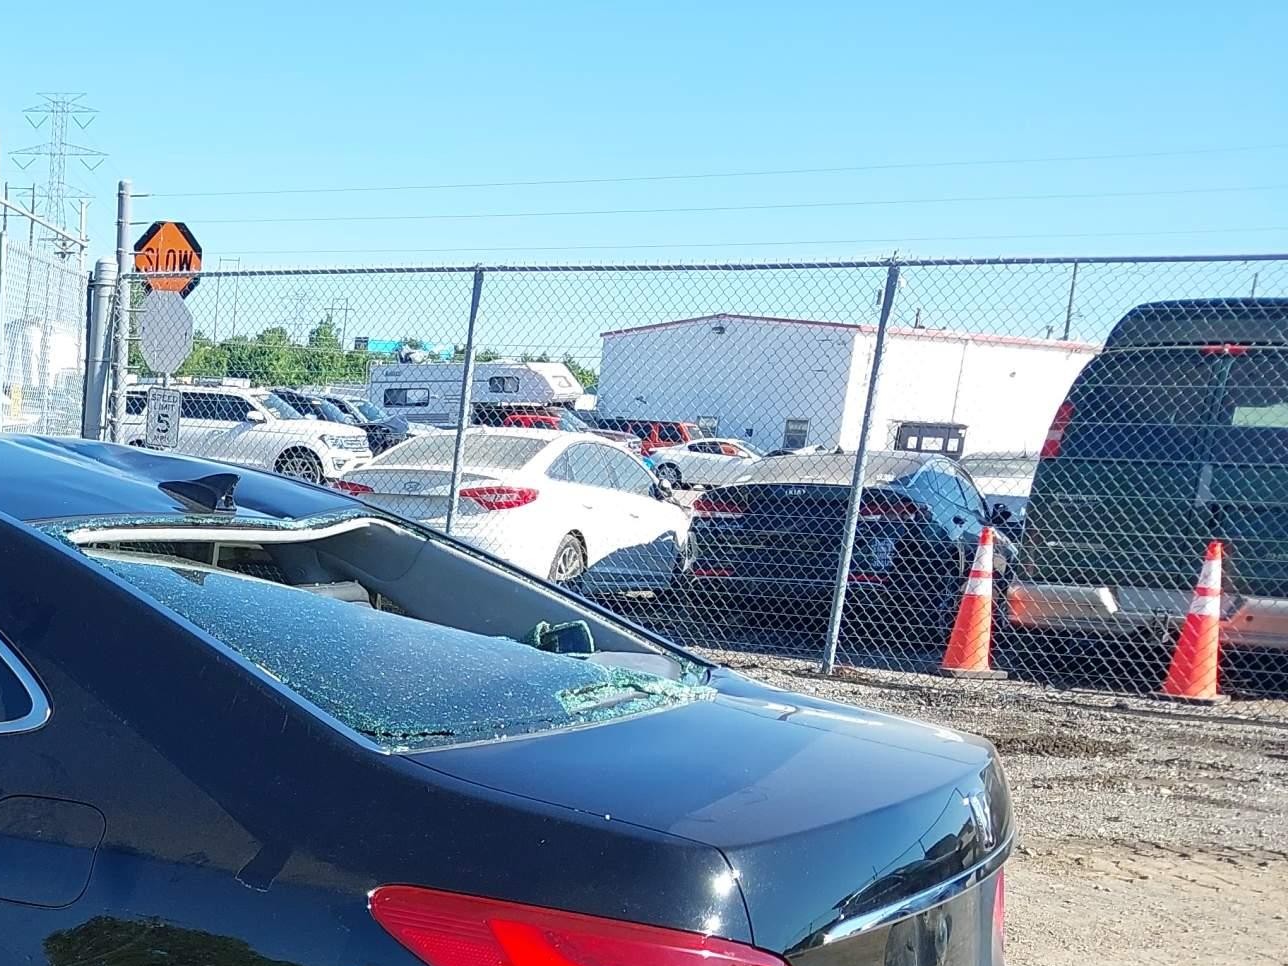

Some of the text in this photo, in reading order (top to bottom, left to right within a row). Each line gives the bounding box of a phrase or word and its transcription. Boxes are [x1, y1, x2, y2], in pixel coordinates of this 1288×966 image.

[144, 247, 193, 272] SLOW
[151, 393, 178, 404] SPEED
[153, 402, 176, 411] LIMIT
[156, 413, 170, 433] 5
